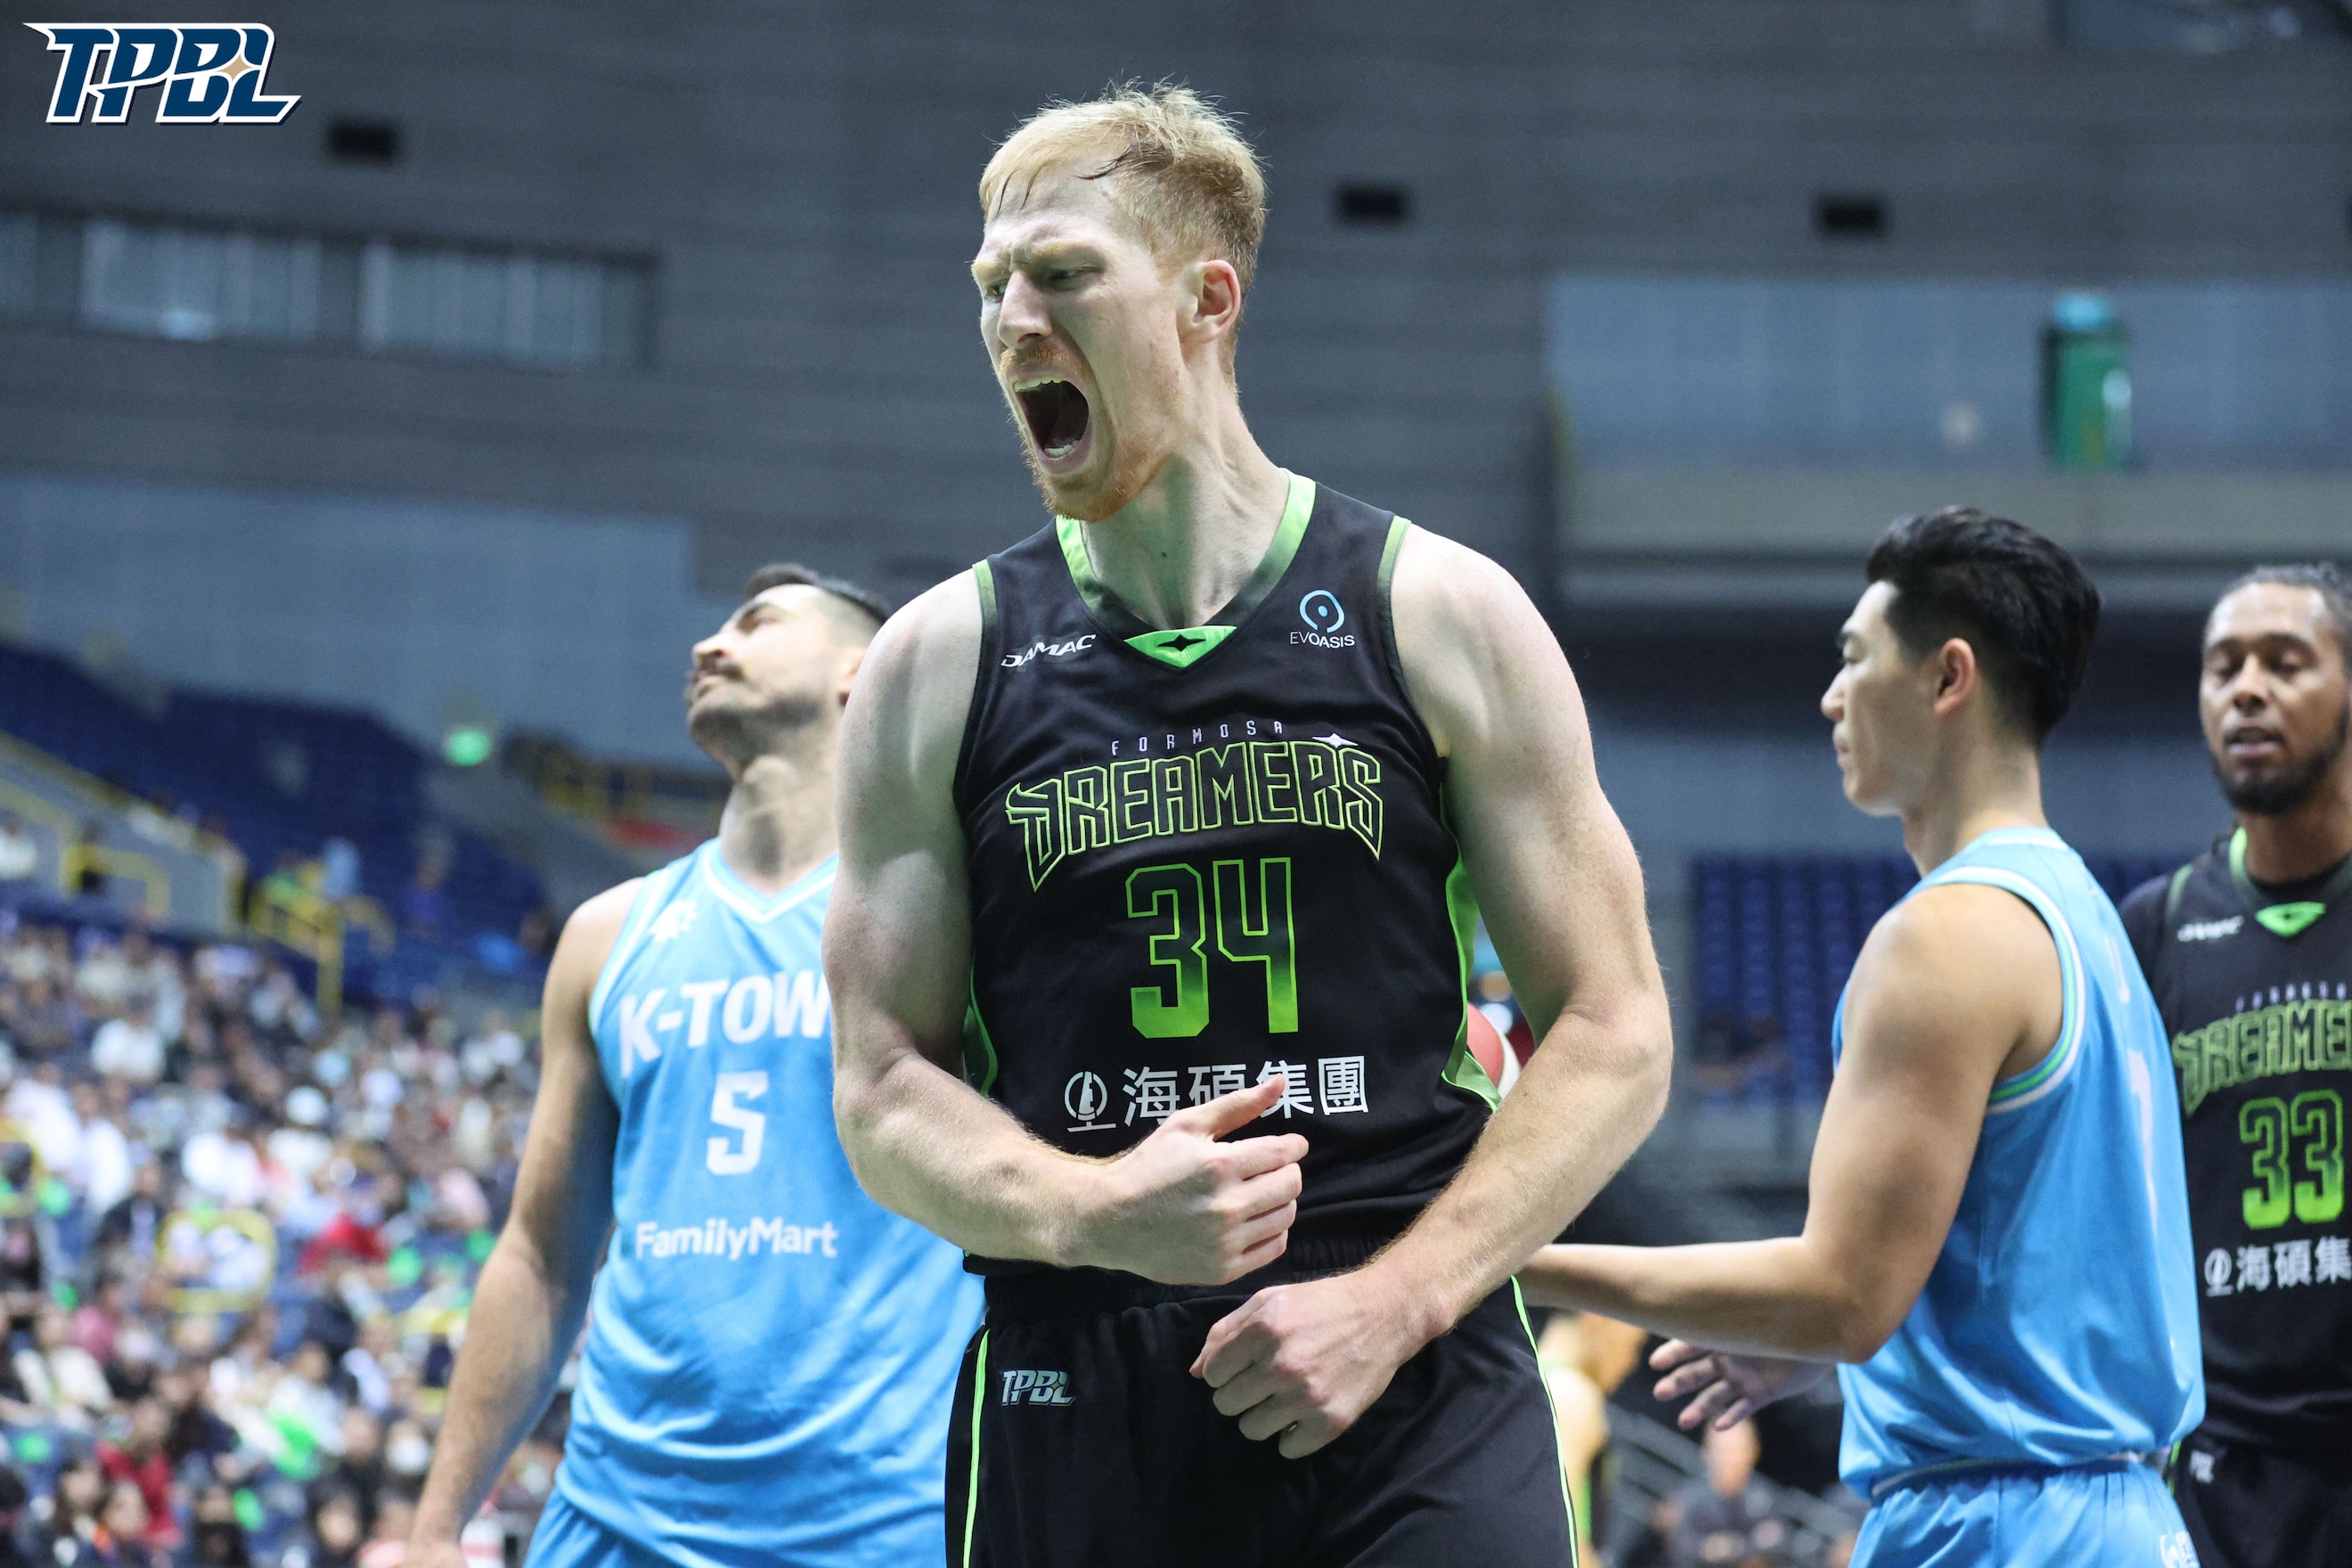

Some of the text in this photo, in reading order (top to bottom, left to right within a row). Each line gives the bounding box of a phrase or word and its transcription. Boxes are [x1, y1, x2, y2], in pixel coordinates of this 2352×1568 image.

[1000, 633, 1097, 667] DAMAC
[1289, 631, 1355, 649] EVOASIS
[1111, 720, 1283, 755] FORMOSA
[1005, 741, 1385, 891] DREAMERS
[1125, 856, 1299, 1039] 34
[2171, 999, 2352, 1118] DREAME
[706, 1070, 770, 1175] 5
[2238, 1089, 2345, 1229] 33
[635, 1217, 838, 1261] FamilyMart
[1001, 1369, 1076, 1406] TPBL
